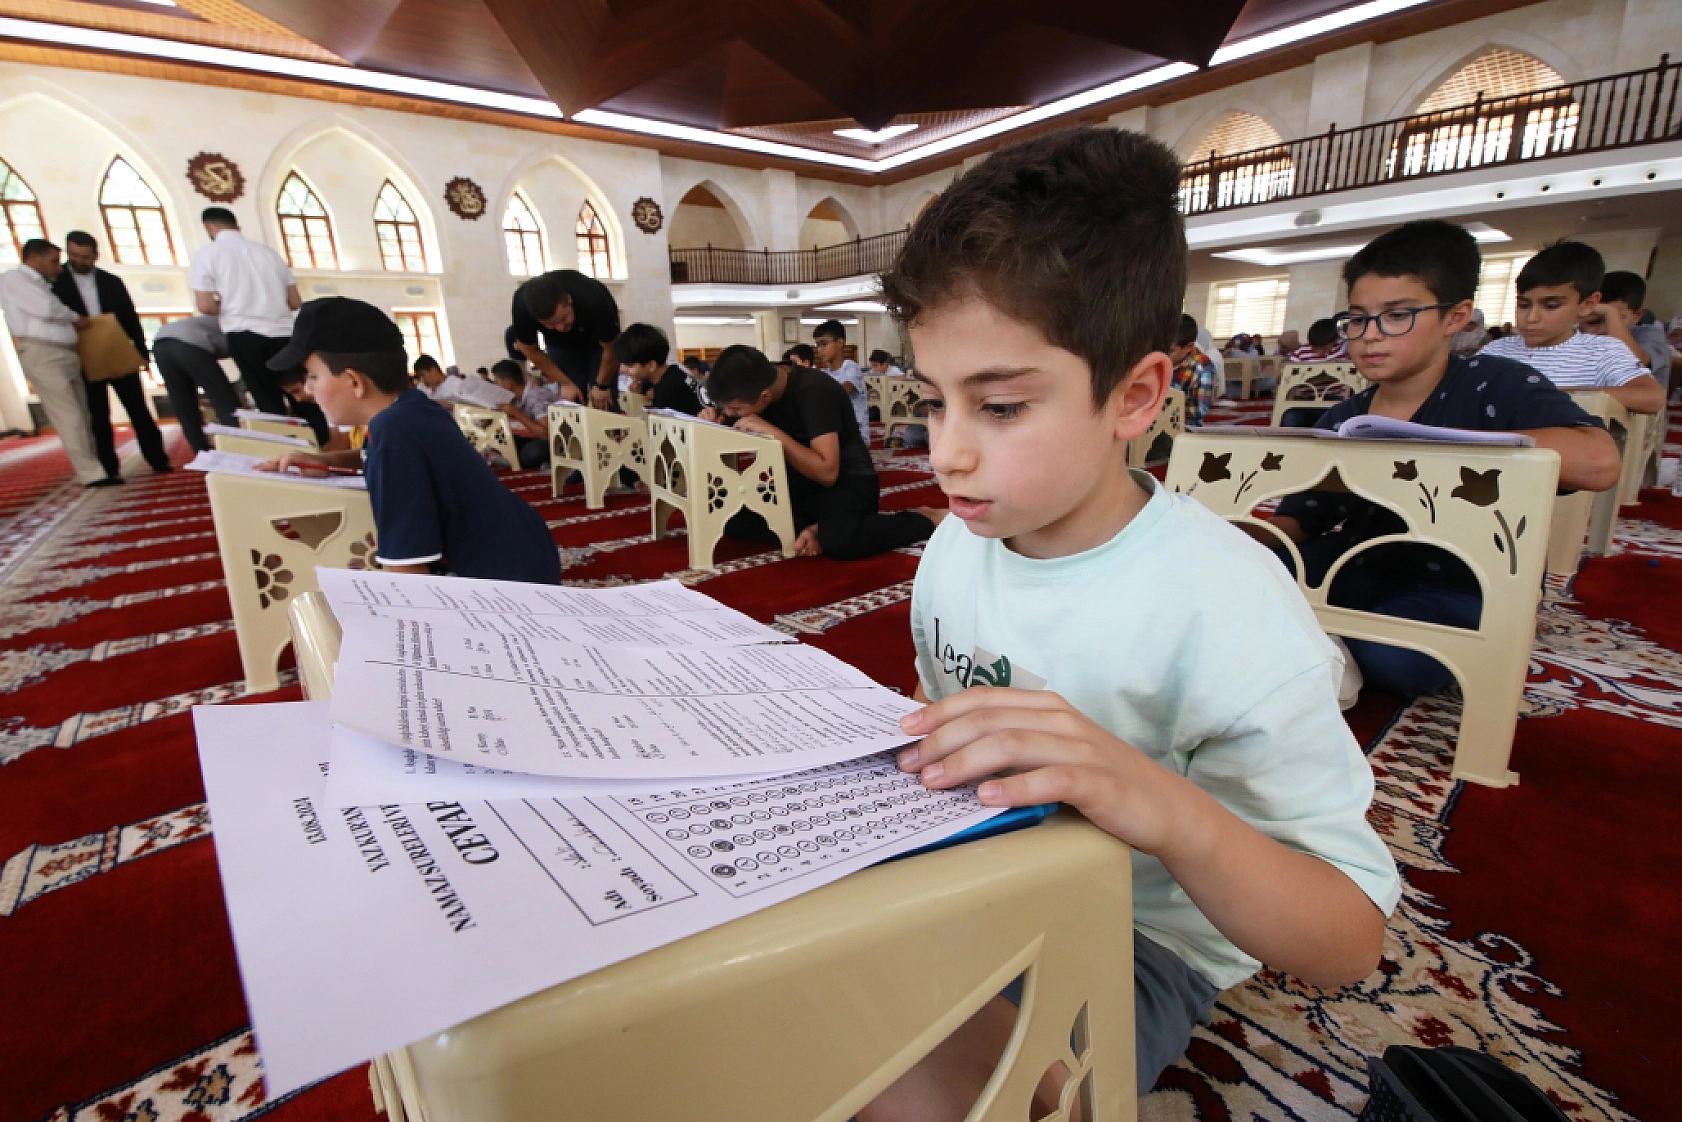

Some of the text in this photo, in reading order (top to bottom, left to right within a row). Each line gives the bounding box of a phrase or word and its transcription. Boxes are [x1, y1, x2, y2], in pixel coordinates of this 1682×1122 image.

[383, 815, 441, 876] SURELERİ
[426, 801, 500, 865] CEVAP
[361, 845, 391, 873] YAZ
[424, 874, 477, 933] NAMAZ
[604, 889, 632, 909] Adı
[620, 867, 663, 902] Soyadı
